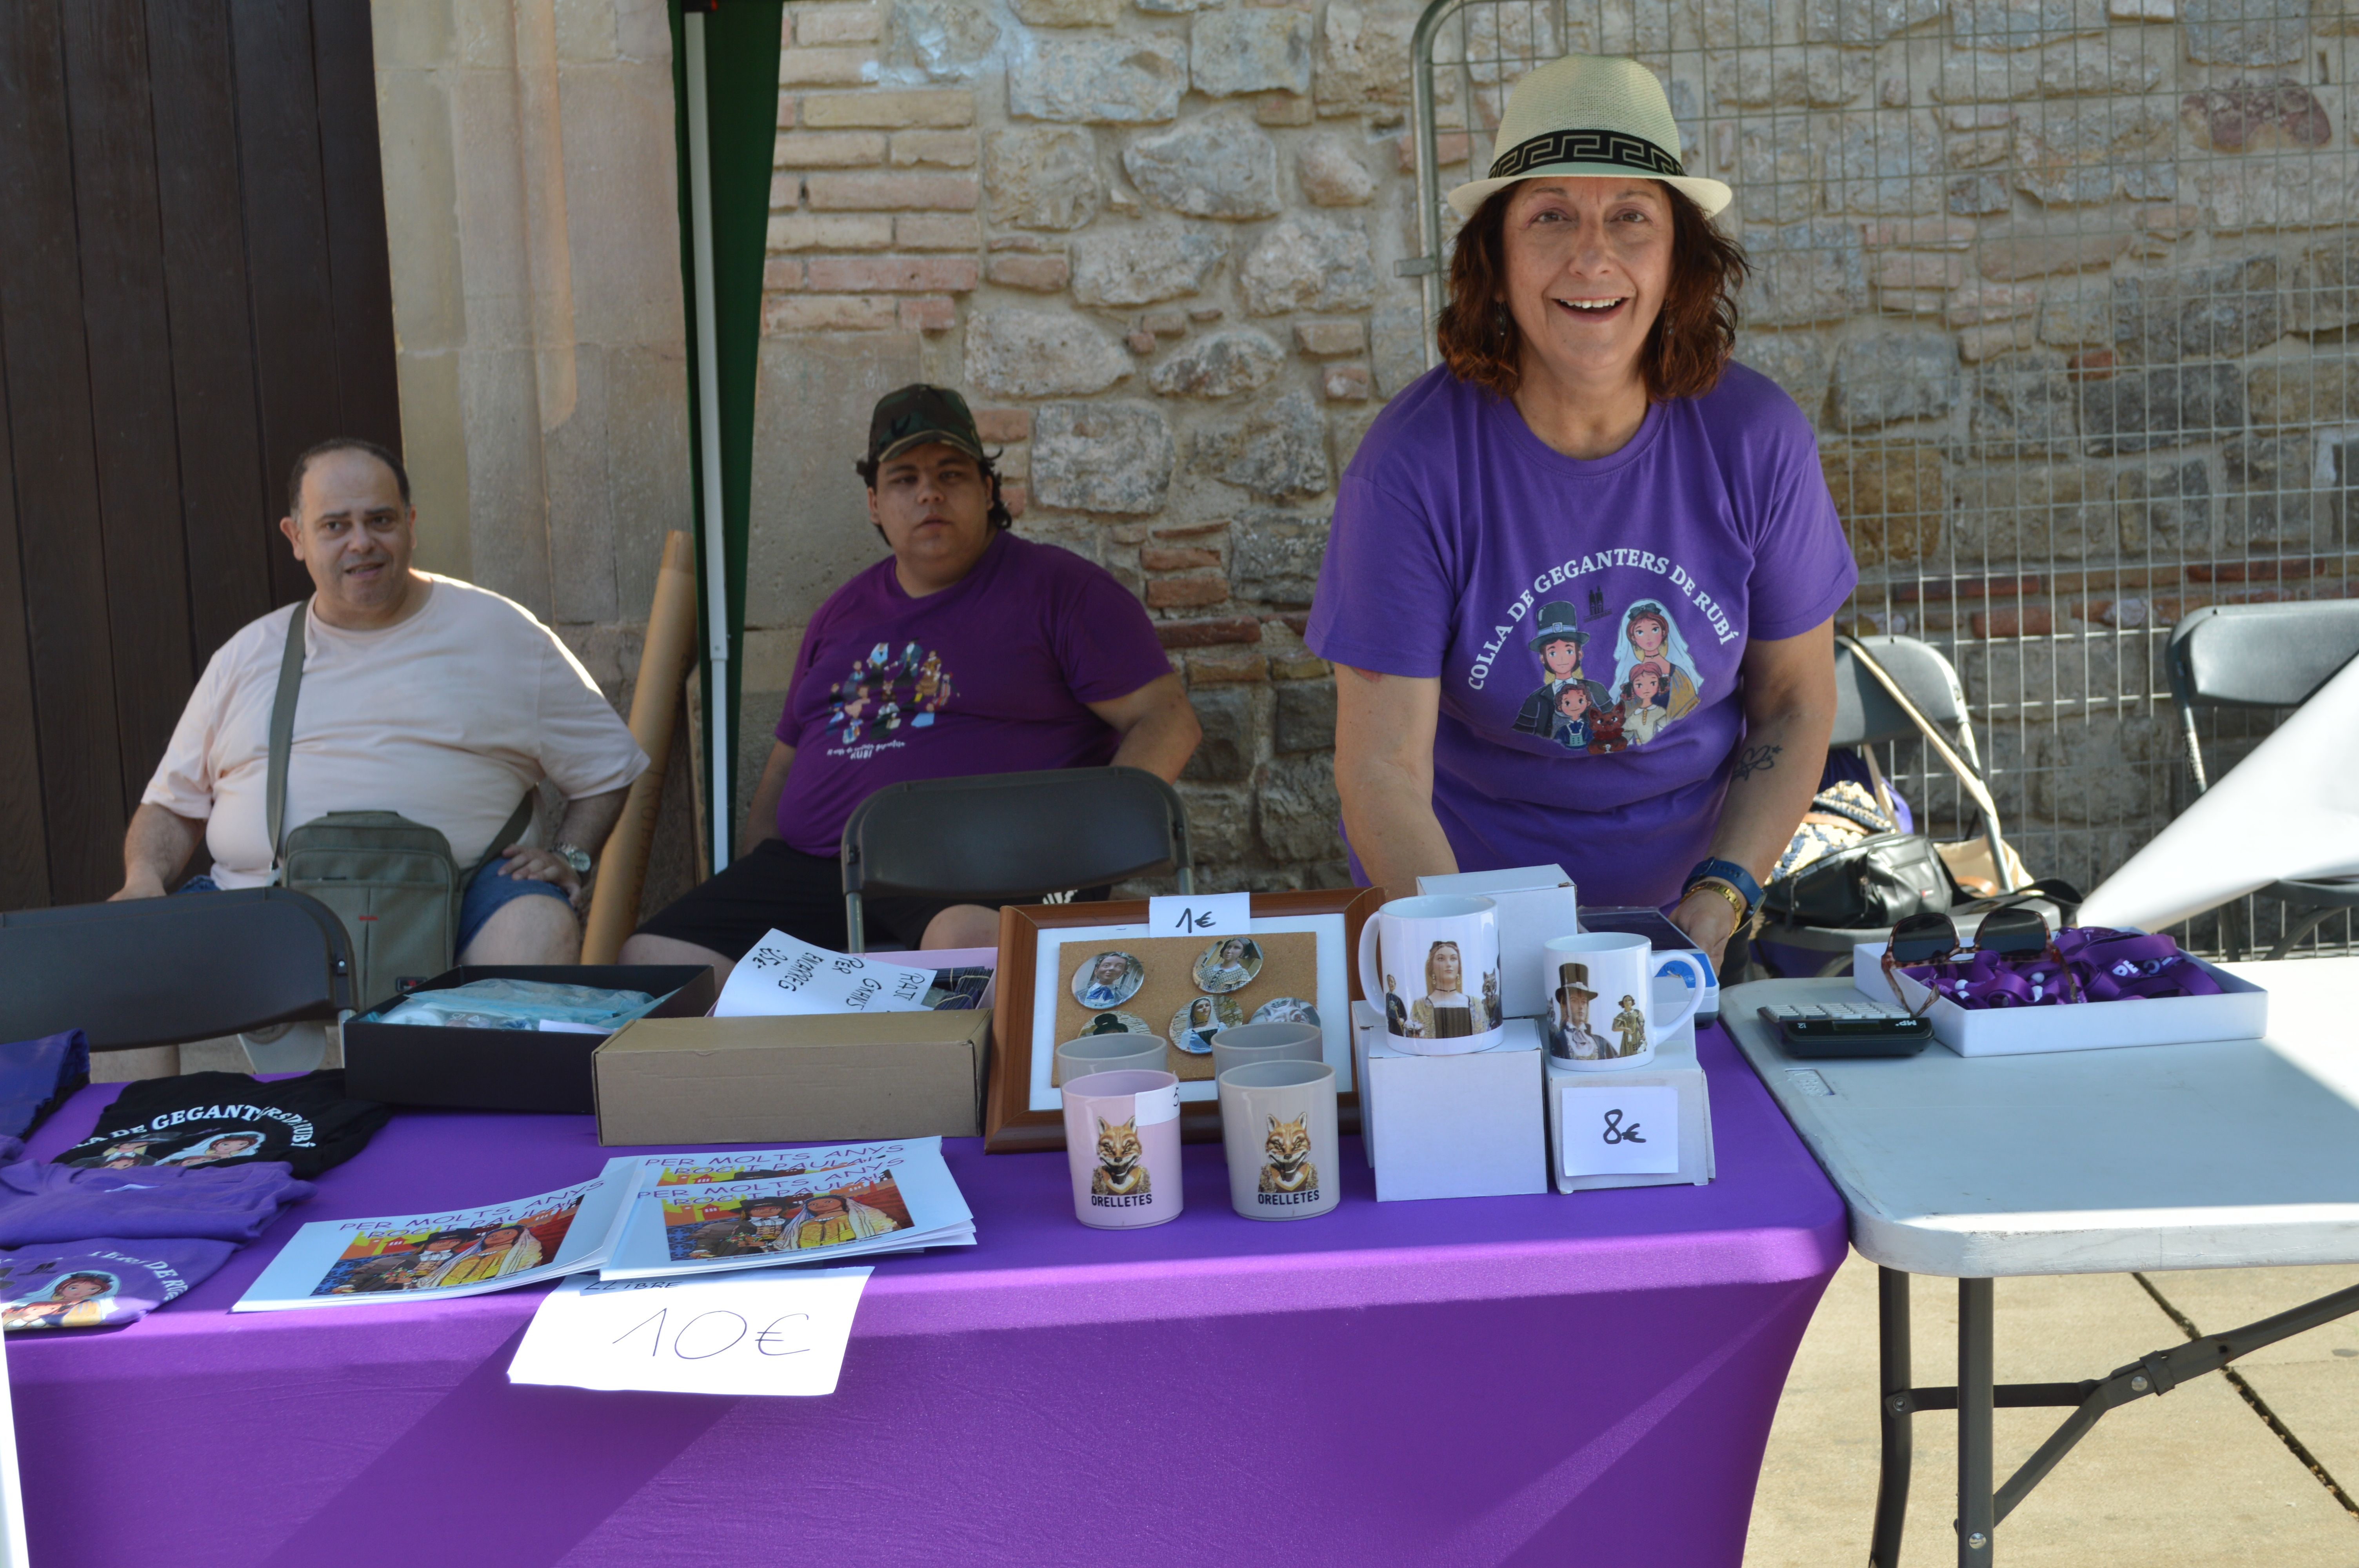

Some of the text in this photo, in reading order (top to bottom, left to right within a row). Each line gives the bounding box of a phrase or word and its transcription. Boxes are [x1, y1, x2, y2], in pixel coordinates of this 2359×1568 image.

[1468, 548, 1739, 691] COLLA DE GEGANTERS DE RUBÍ
[1176, 907, 1216, 933] 1€
[832, 957, 865, 974] PER
[109, 1124, 147, 1138] DE
[1603, 1109, 1647, 1144] 8€
[645, 1144, 905, 1167] PER MOLTS ANYS
[637, 1157, 905, 1200] PER MOLTS ANYS
[674, 1166, 734, 1175] ROC
[339, 1180, 605, 1232] PER MOLTS ANYS
[672, 1194, 733, 1207] ROC
[1091, 1193, 1153, 1208] ORELLETES
[1258, 1189, 1320, 1206] ORELLETES
[367, 1227, 429, 1240] ROC
[443, 1224, 459, 1233] I
[142, 1261, 178, 1279] DE
[612, 1307, 811, 1359] 10€
